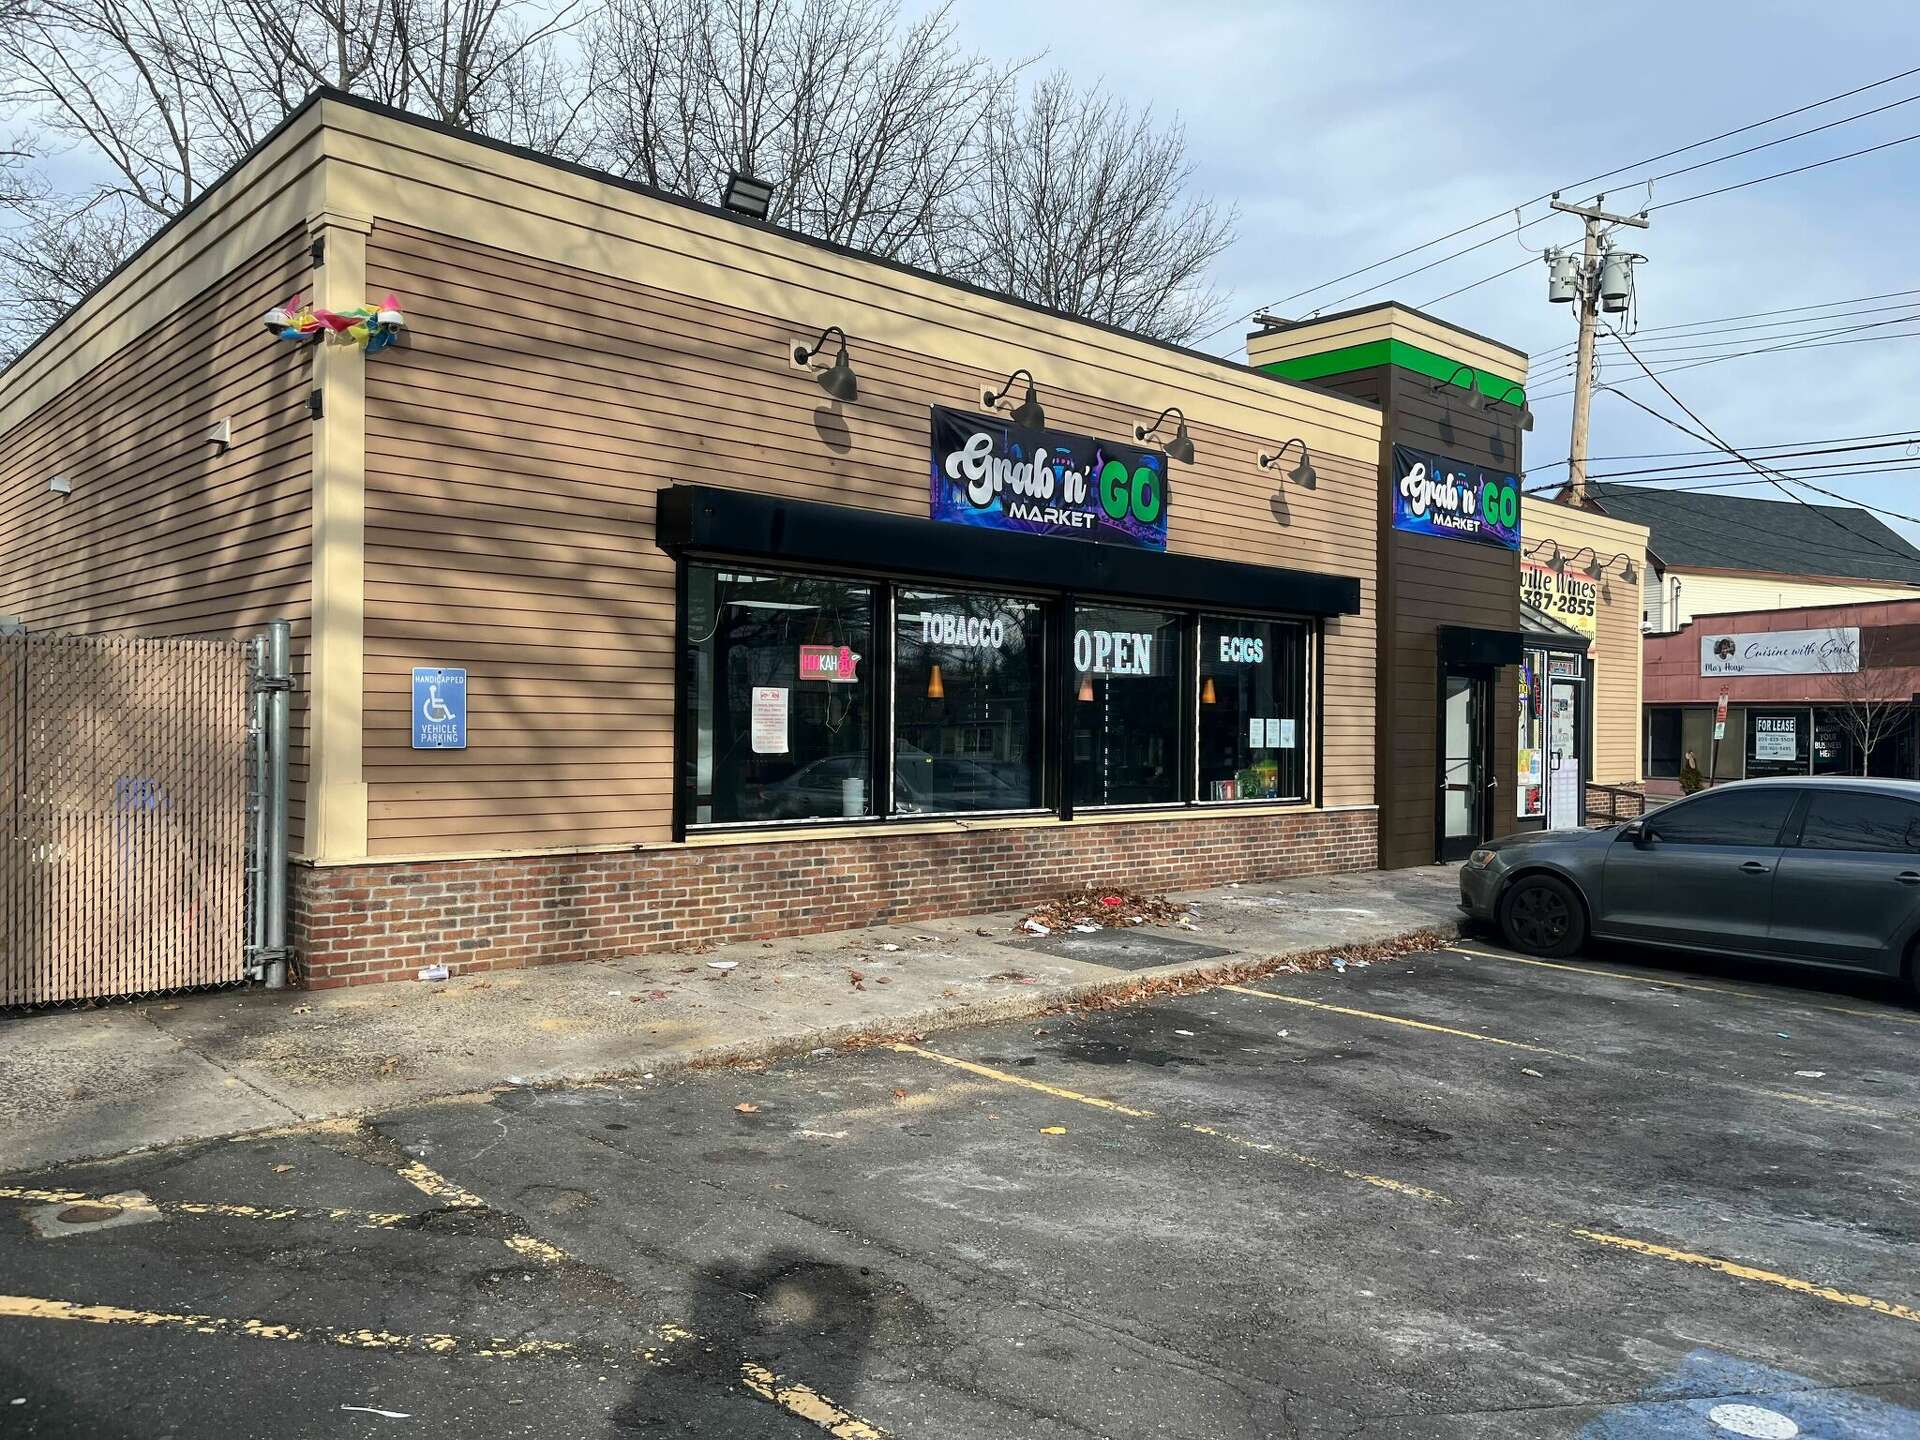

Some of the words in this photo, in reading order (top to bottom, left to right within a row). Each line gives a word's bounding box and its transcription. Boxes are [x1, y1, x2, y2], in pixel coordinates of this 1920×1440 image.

[945, 432, 1054, 505] Grab
[1100, 460, 1160, 523] GO
[1400, 462, 1458, 515] Grab
[1482, 481, 1516, 527] GO
[1009, 502, 1095, 529] MARKET
[1433, 512, 1481, 532] MARKET
[1556, 573, 1596, 598] Wines
[920, 612, 1003, 648] TOBACCO
[1074, 629, 1152, 675] OPEN
[1744, 642, 1788, 660] Cuisine
[1791, 641, 1816, 657] with
[1820, 638, 1855, 658] Soul
[415, 675, 464, 684] HANDICAPPED
[421, 724, 457, 734] VEHICLE
[1758, 720, 1772, 731] FOR
[1773, 720, 1794, 732] LEASE
[421, 733, 458, 743] PARKING
